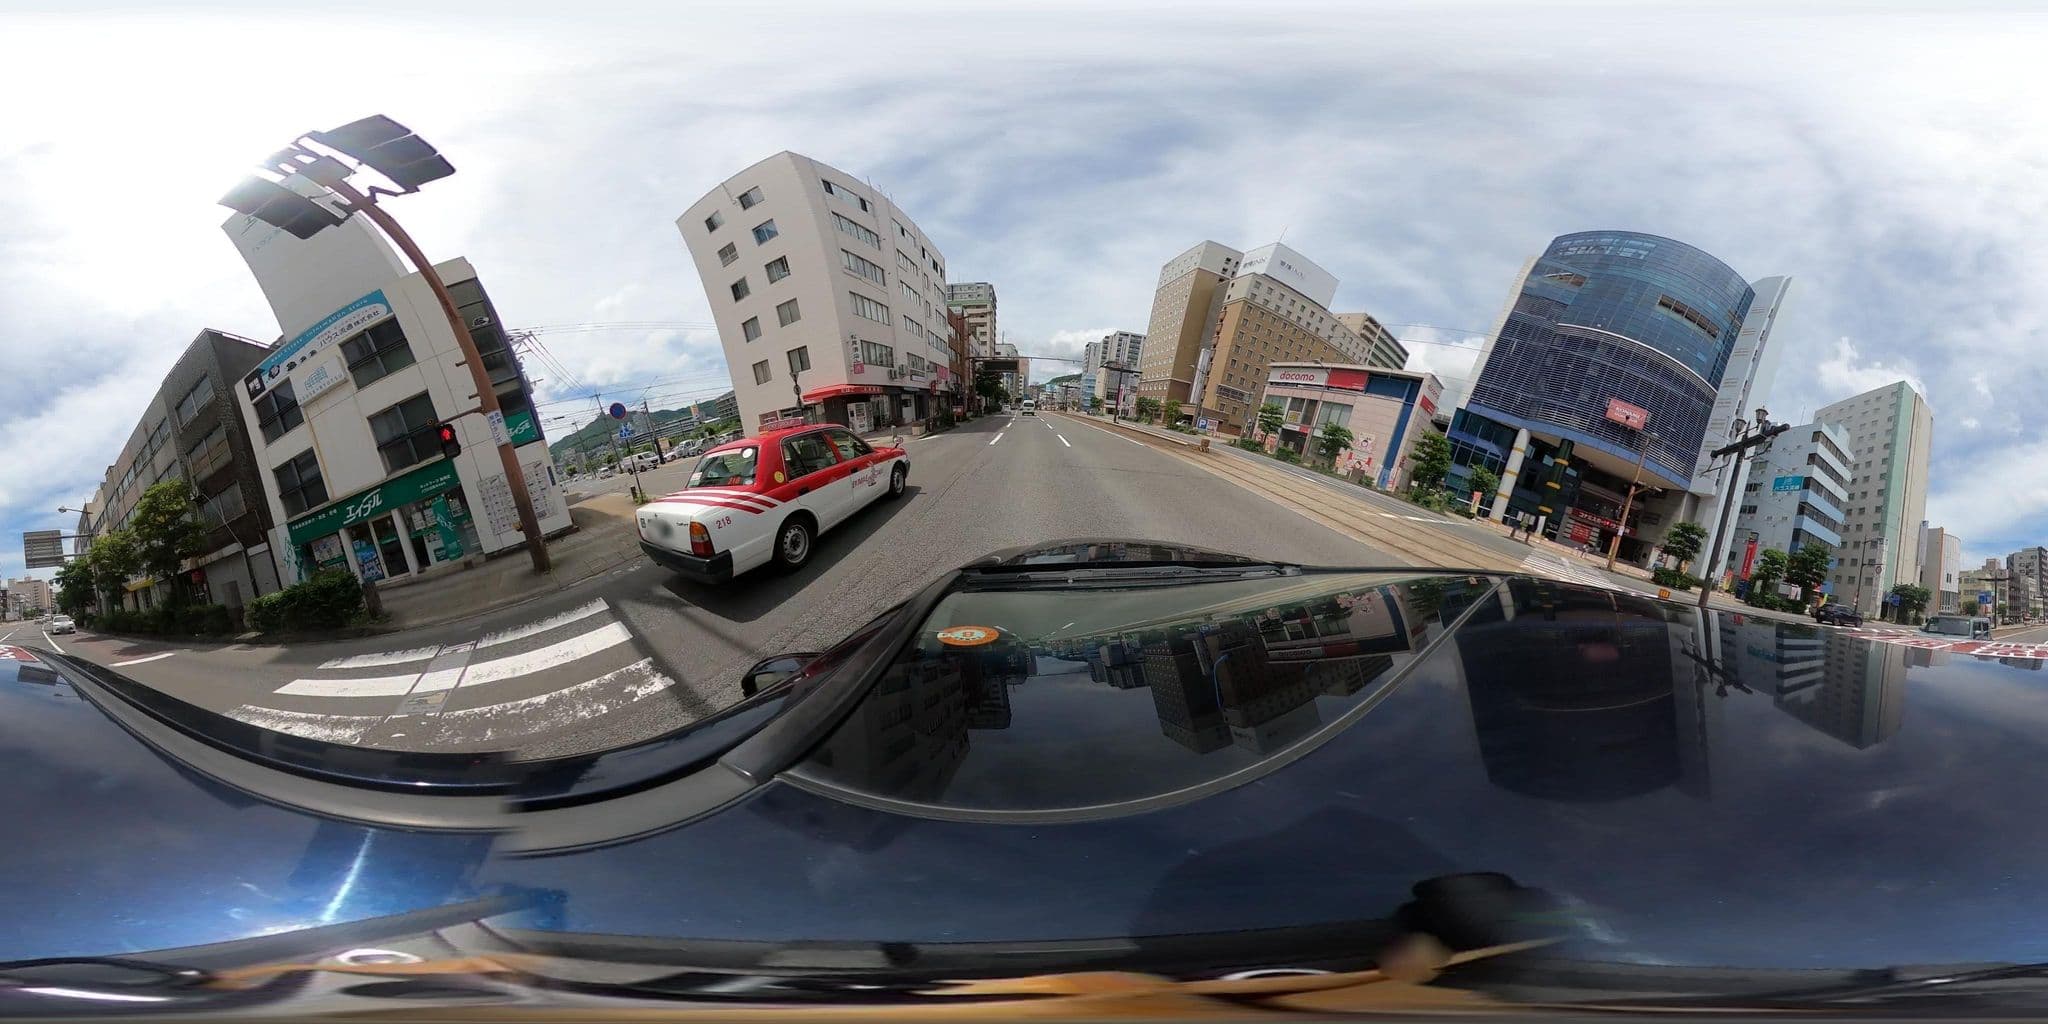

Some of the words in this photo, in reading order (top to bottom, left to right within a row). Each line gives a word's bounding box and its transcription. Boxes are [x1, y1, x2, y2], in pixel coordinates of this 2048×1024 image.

[1279, 370, 1315, 382] docomo
[343, 488, 382, 525] エイブル
[715, 516, 732, 530] 218
